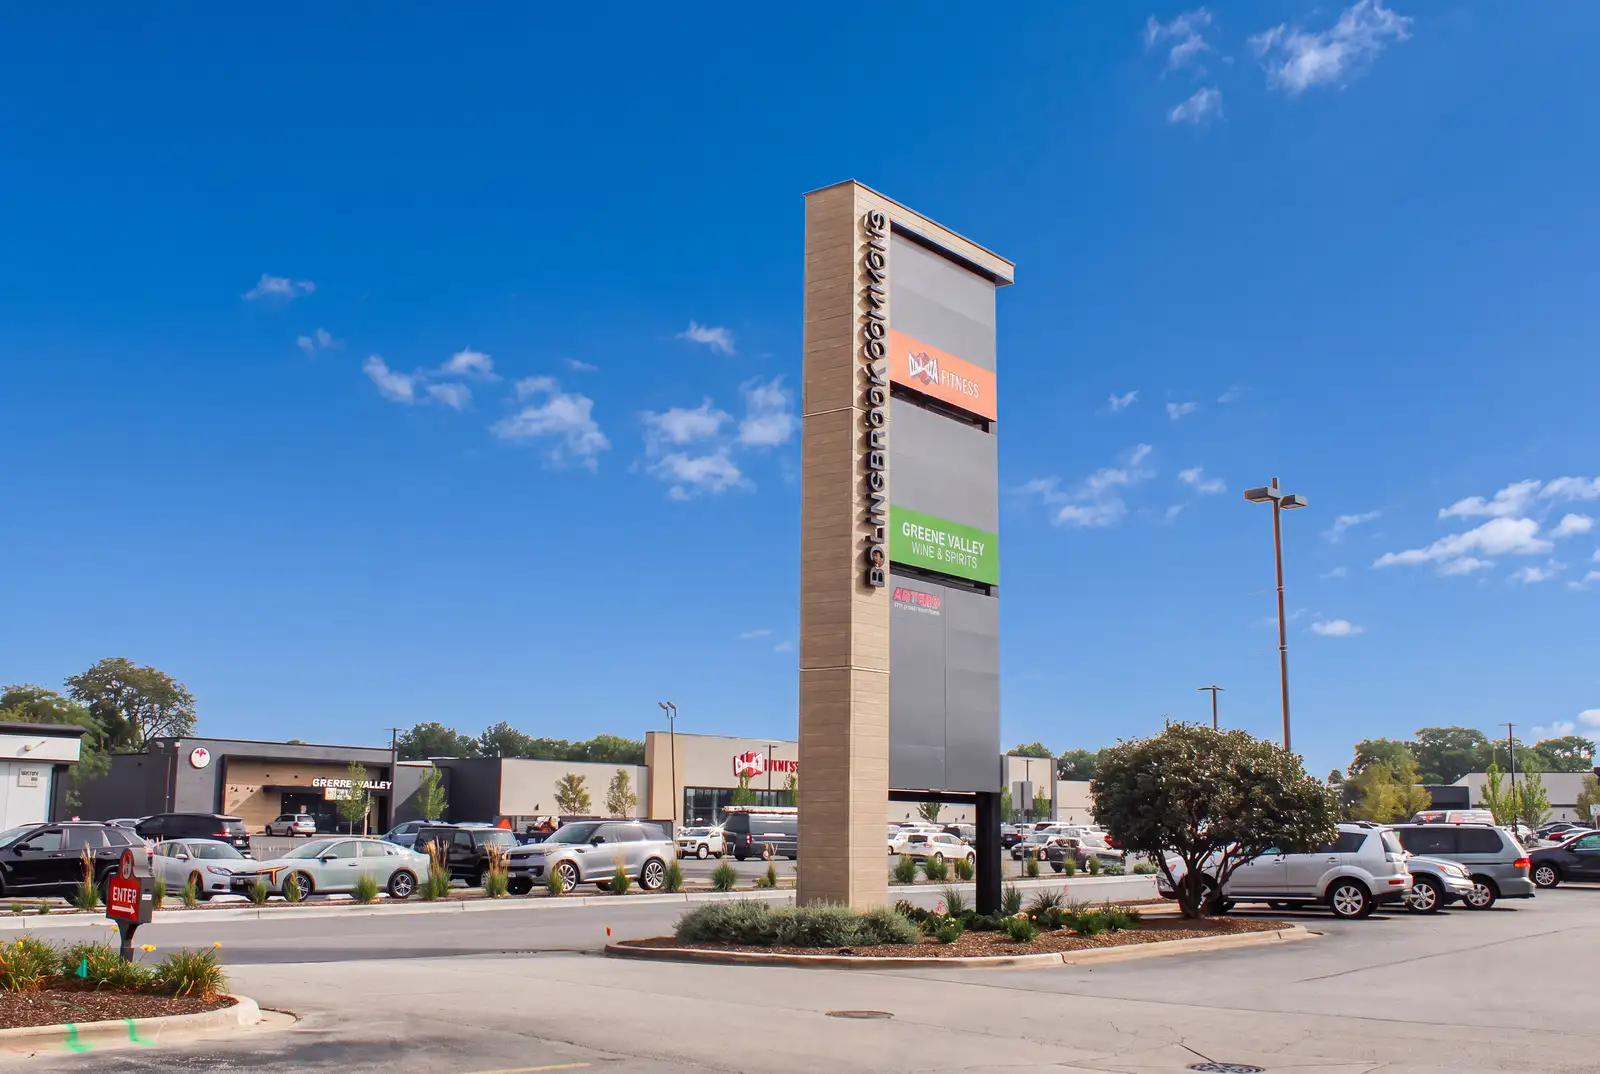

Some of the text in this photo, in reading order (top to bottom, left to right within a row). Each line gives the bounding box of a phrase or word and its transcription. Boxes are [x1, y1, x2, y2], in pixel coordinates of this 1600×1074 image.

[941, 368, 979, 398] FITNESS
[866, 208, 886, 588] BOLINGBROOK COMMONS
[902, 521, 985, 556] GREENE VALLEY
[911, 541, 978, 569] WINE & SPIRITS
[357, 780, 392, 789] VALLEY
[112, 886, 137, 904] ENTER
